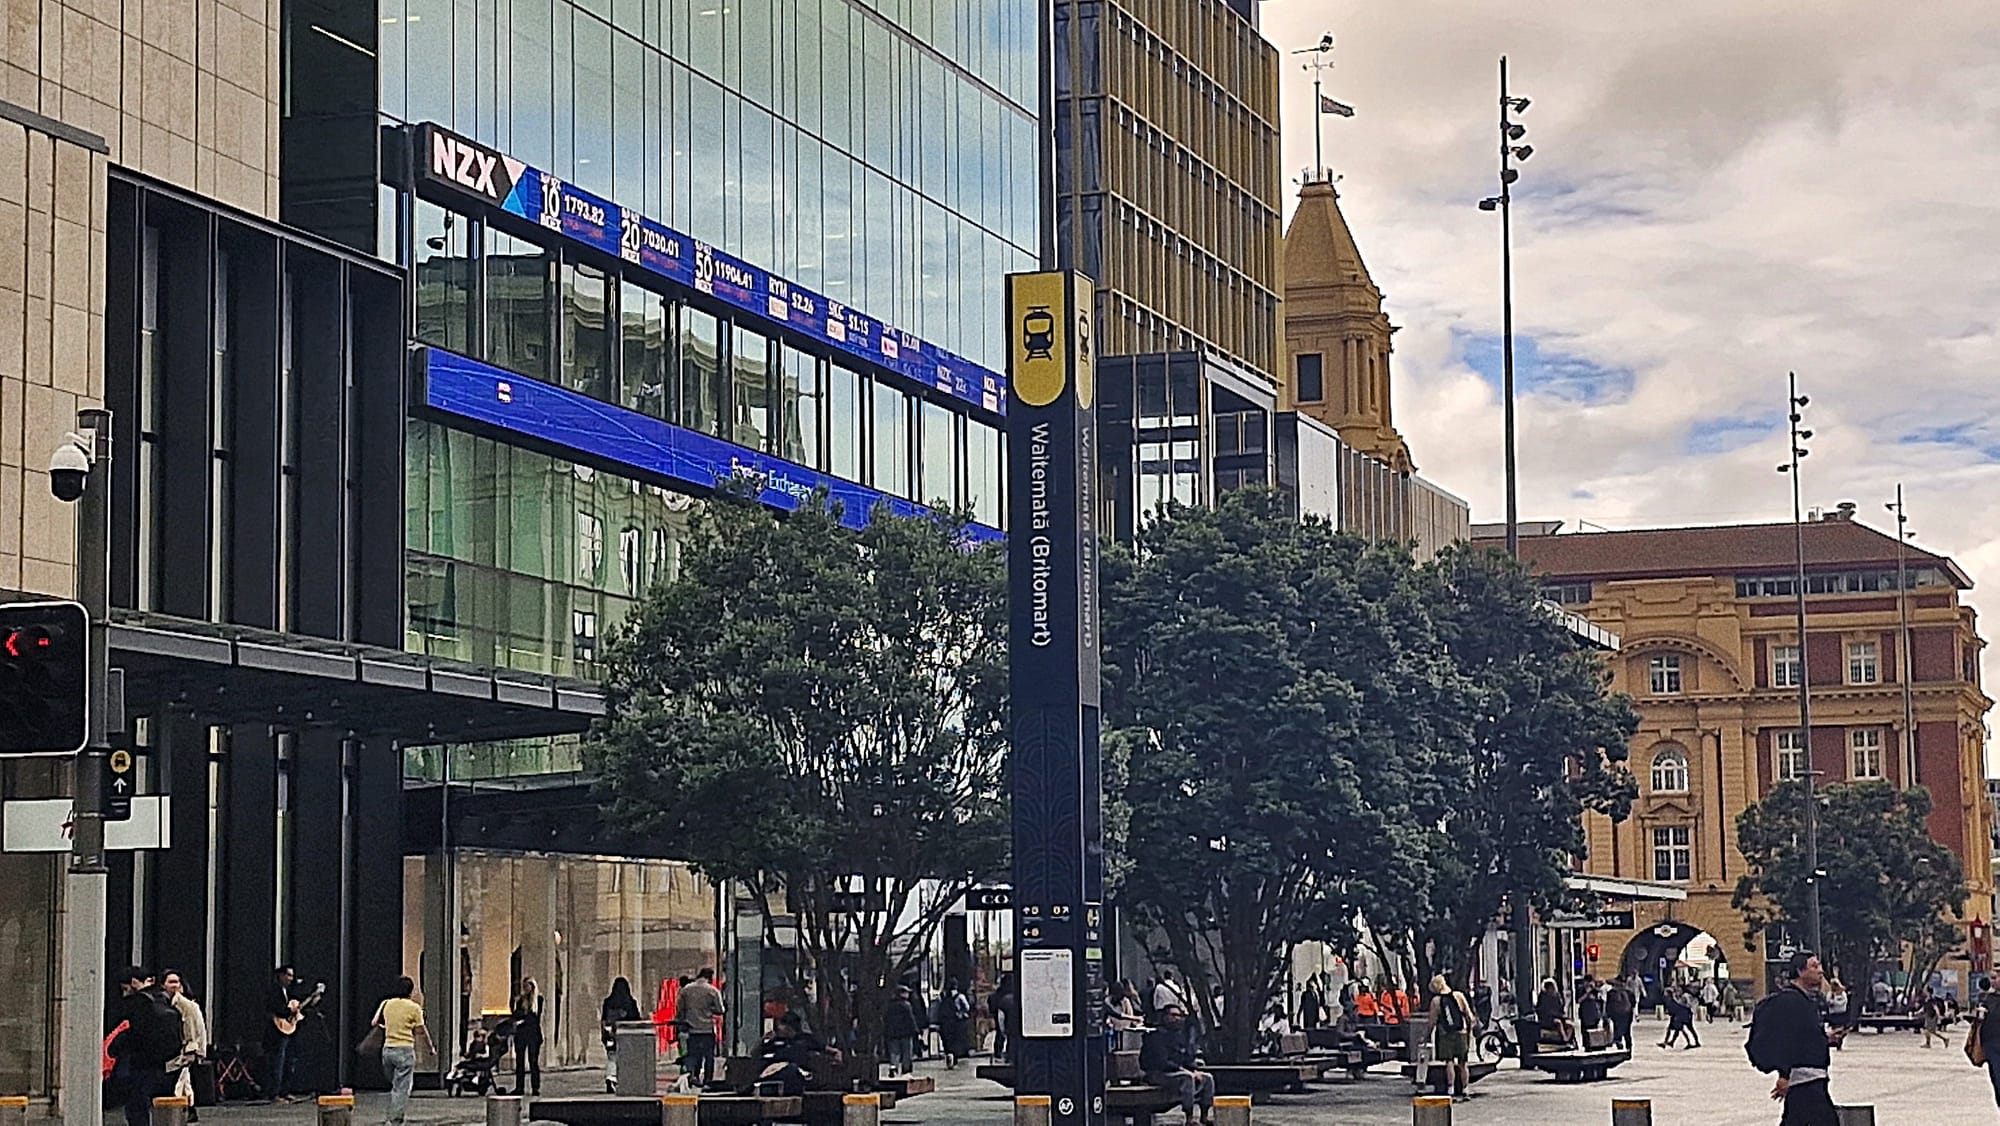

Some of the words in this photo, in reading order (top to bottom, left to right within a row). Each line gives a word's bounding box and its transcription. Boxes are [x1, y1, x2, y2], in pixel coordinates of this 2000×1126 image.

[433, 131, 498, 199] NZX
[541, 184, 560, 218] 10
[564, 194, 605, 226] 1793.82
[621, 219, 641, 252] 20
[695, 250, 713, 282] 50
[1031, 422, 1050, 532] Waitematā
[1030, 536, 1052, 648] (Britomart)
